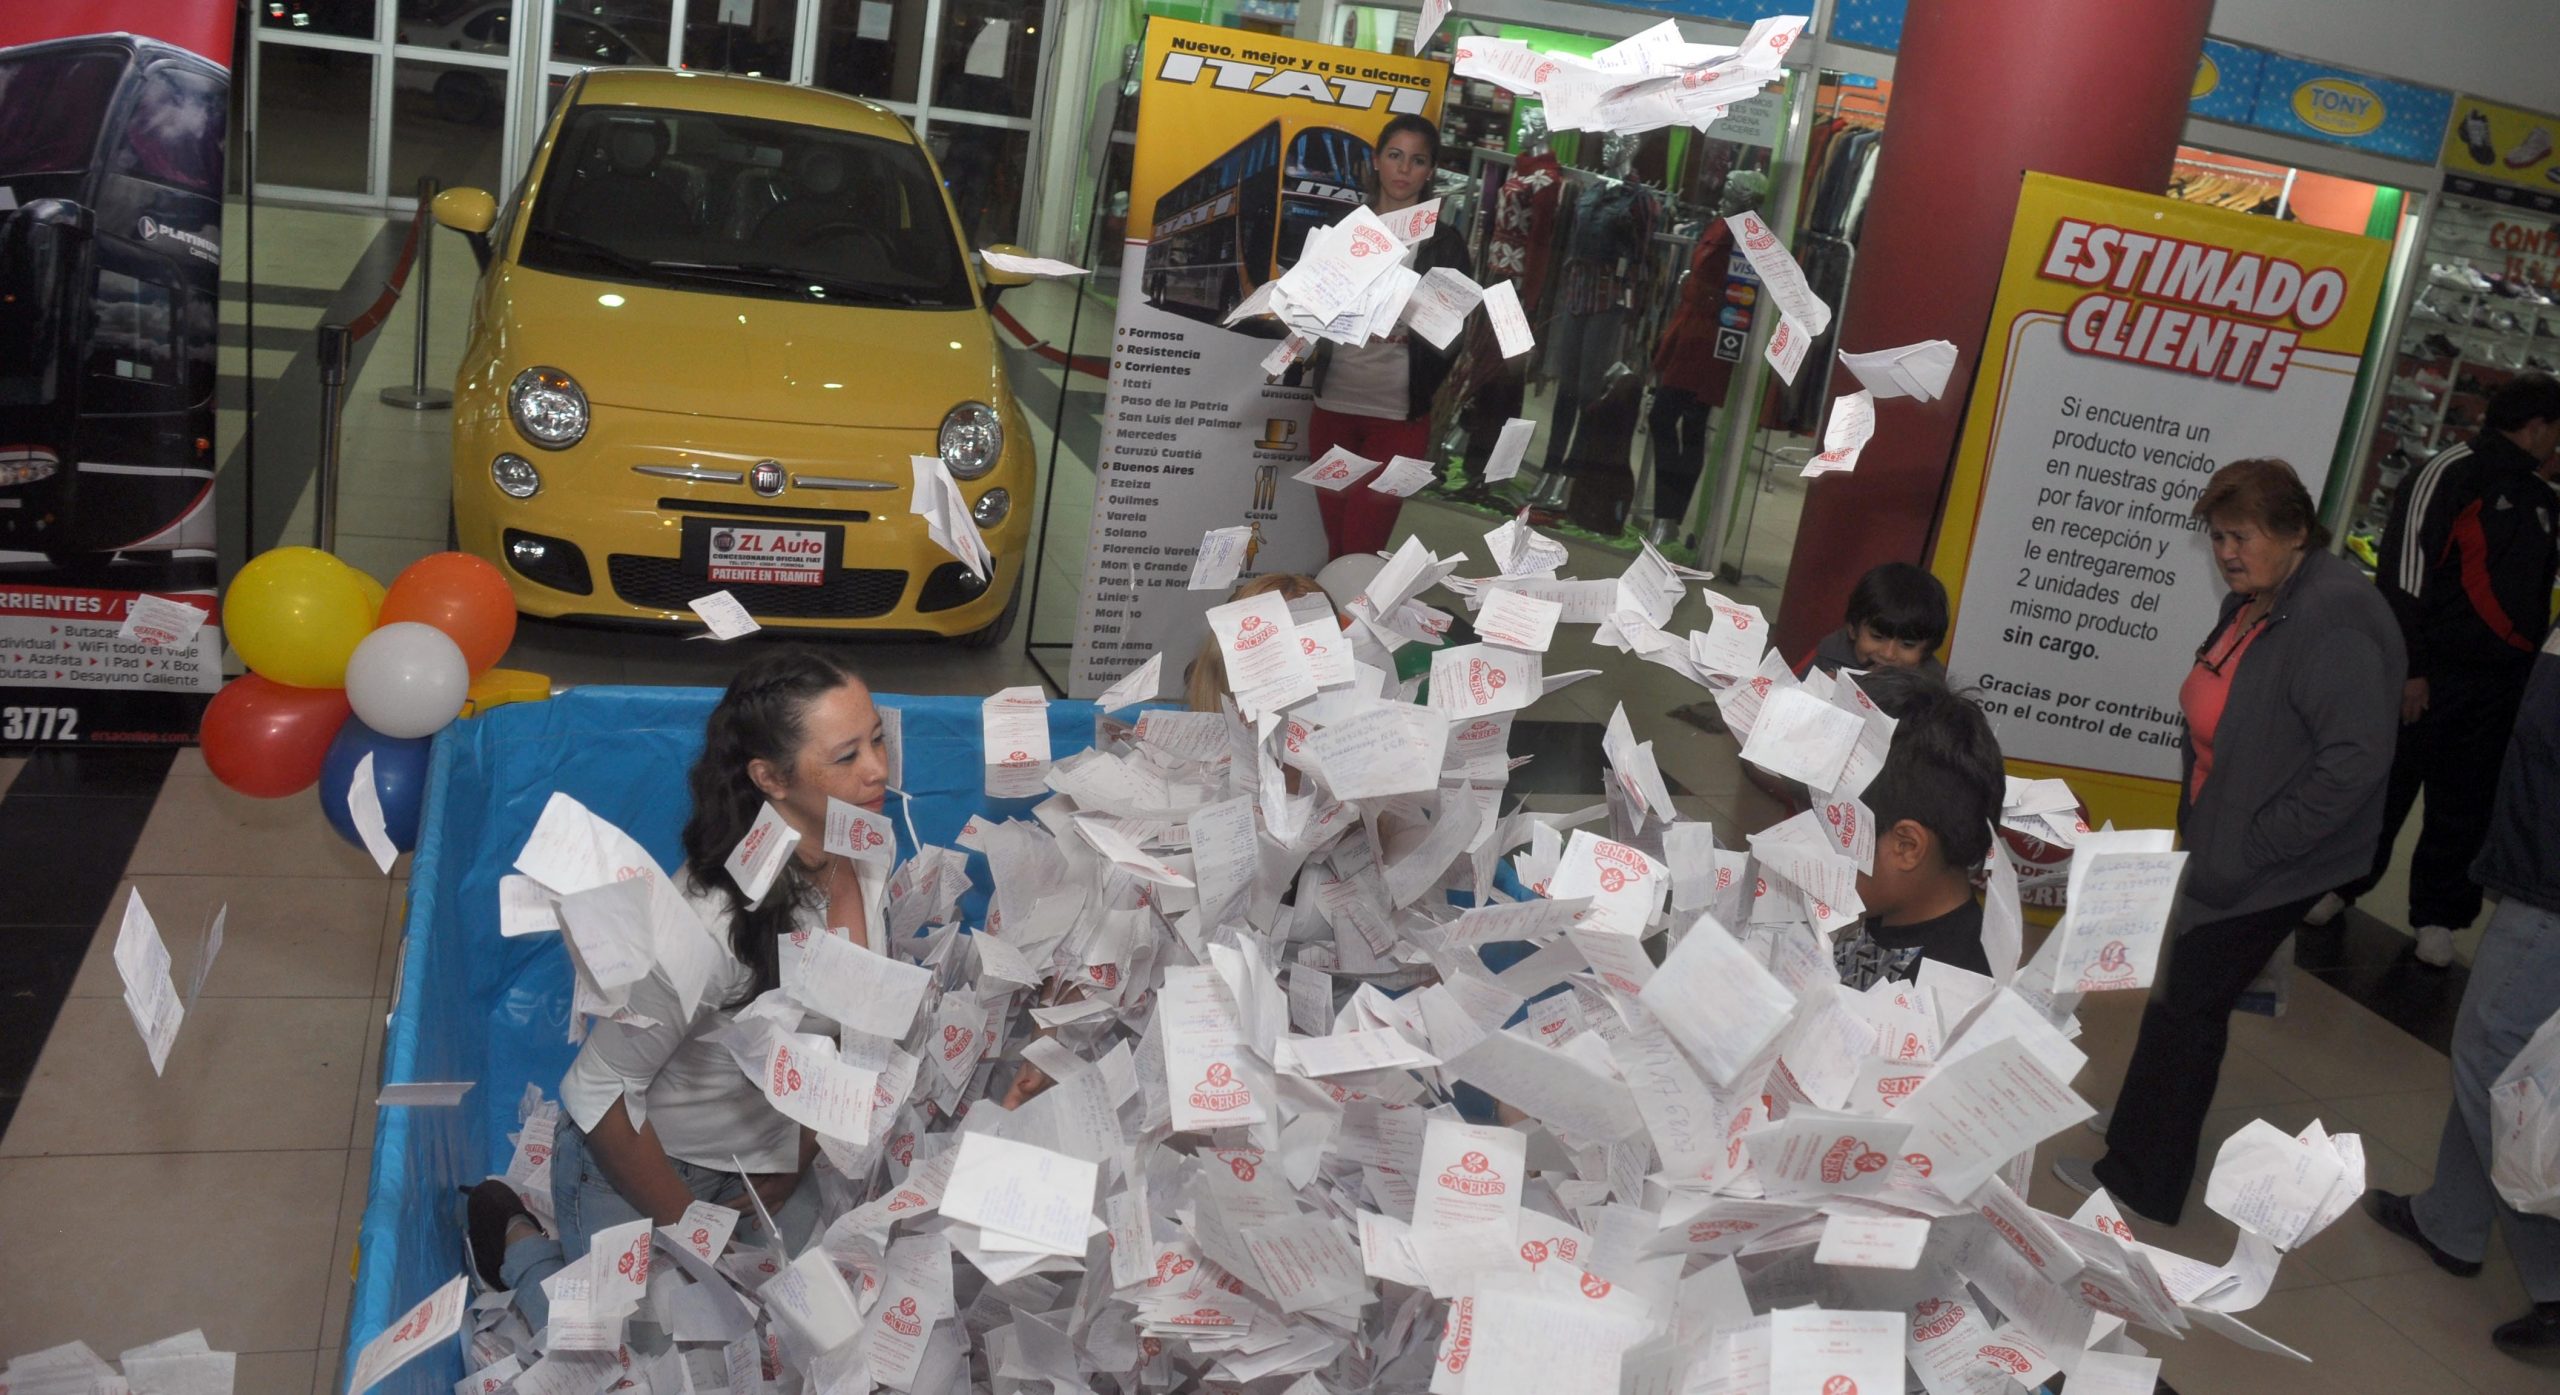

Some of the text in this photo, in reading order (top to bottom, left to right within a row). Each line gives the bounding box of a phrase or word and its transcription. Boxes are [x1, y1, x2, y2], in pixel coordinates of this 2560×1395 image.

[1171, 37, 1431, 87] Nuevo, mejor y a su alcance
[1158, 52, 1430, 117] ITATI
[2312, 88, 2373, 116] TONY
[2490, 221, 2560, 256] CONT
[2043, 219, 2344, 327] ESTIMADO
[1129, 328, 1184, 341] Formosa
[2066, 294, 2300, 388] CLIENTE
[1127, 345, 1200, 359] Resistencia
[1125, 362, 1191, 375] Corrientes
[1123, 379, 1152, 389] Itatí
[1121, 395, 1229, 411] Paso de la Patria
[1119, 412, 1242, 429] San Luis del Palmar
[2061, 396, 2211, 443] Si encuentra un
[1117, 429, 1177, 441] Mercedes
[1115, 446, 1202, 460] Curuzú Cuatiá
[2052, 429, 2216, 474] producto vencido
[1112, 462, 1194, 476] Buenos Aires
[2046, 458, 2070, 476] en
[2075, 464, 2157, 493] nuestras
[758, 472, 779, 487] FIAT
[1110, 479, 1151, 490] Ezeiza
[1109, 495, 1159, 506] Quilmes
[2038, 486, 2072, 507] por
[2075, 489, 2124, 515] favor
[1107, 512, 1147, 522] Varela
[1244, 511, 1278, 520] Cena
[1105, 528, 1147, 539] Solano
[2032, 516, 2170, 559] en recepción y
[737, 534, 763, 552] ZL
[769, 536, 822, 554] Auto
[1103, 544, 1160, 555] Florencio
[713, 553, 774, 562] CONCESIONARIO
[1101, 561, 1188, 572] Mone Grande
[2024, 539, 2176, 586] le entregaremos
[712, 568, 820, 583] PATENTE EN TRAMITE
[1099, 577, 1144, 587] Puene
[1147, 578, 1162, 587] La
[2017, 568, 2161, 613] 2 unidades del
[2010, 598, 2158, 642] mismo producto
[65, 625, 120, 638] Butacas
[1234, 625, 1279, 651] CACERES
[78, 641, 108, 652] WiFi
[114, 642, 145, 655] todo
[167, 648, 199, 661] viaje
[2003, 626, 2100, 660] sin cargo.
[29, 654, 82, 666] Azafata
[113, 657, 139, 668] Pad
[160, 660, 169, 671] X
[174, 661, 199, 672] Box
[70, 671, 139, 684] Desayuno
[143, 672, 199, 686] Caliente
[1088, 672, 1122, 682] Luján
[1469, 658, 1487, 705] CACERES
[1979, 674, 2051, 700] Gracias
[2057, 692, 2091, 708] por
[2, 707, 78, 740] 3772
[2014, 705, 2031, 720] el
[2036, 711, 2105, 734] control
[2109, 722, 2132, 739] de
[1594, 841, 1650, 875] CACERES
[1189, 1091, 1251, 1112] CACERES
[1438, 1174, 1505, 1196] CACERES
[882, 1312, 922, 1337] CACERES
[1913, 1306, 1965, 1342] CACERES
